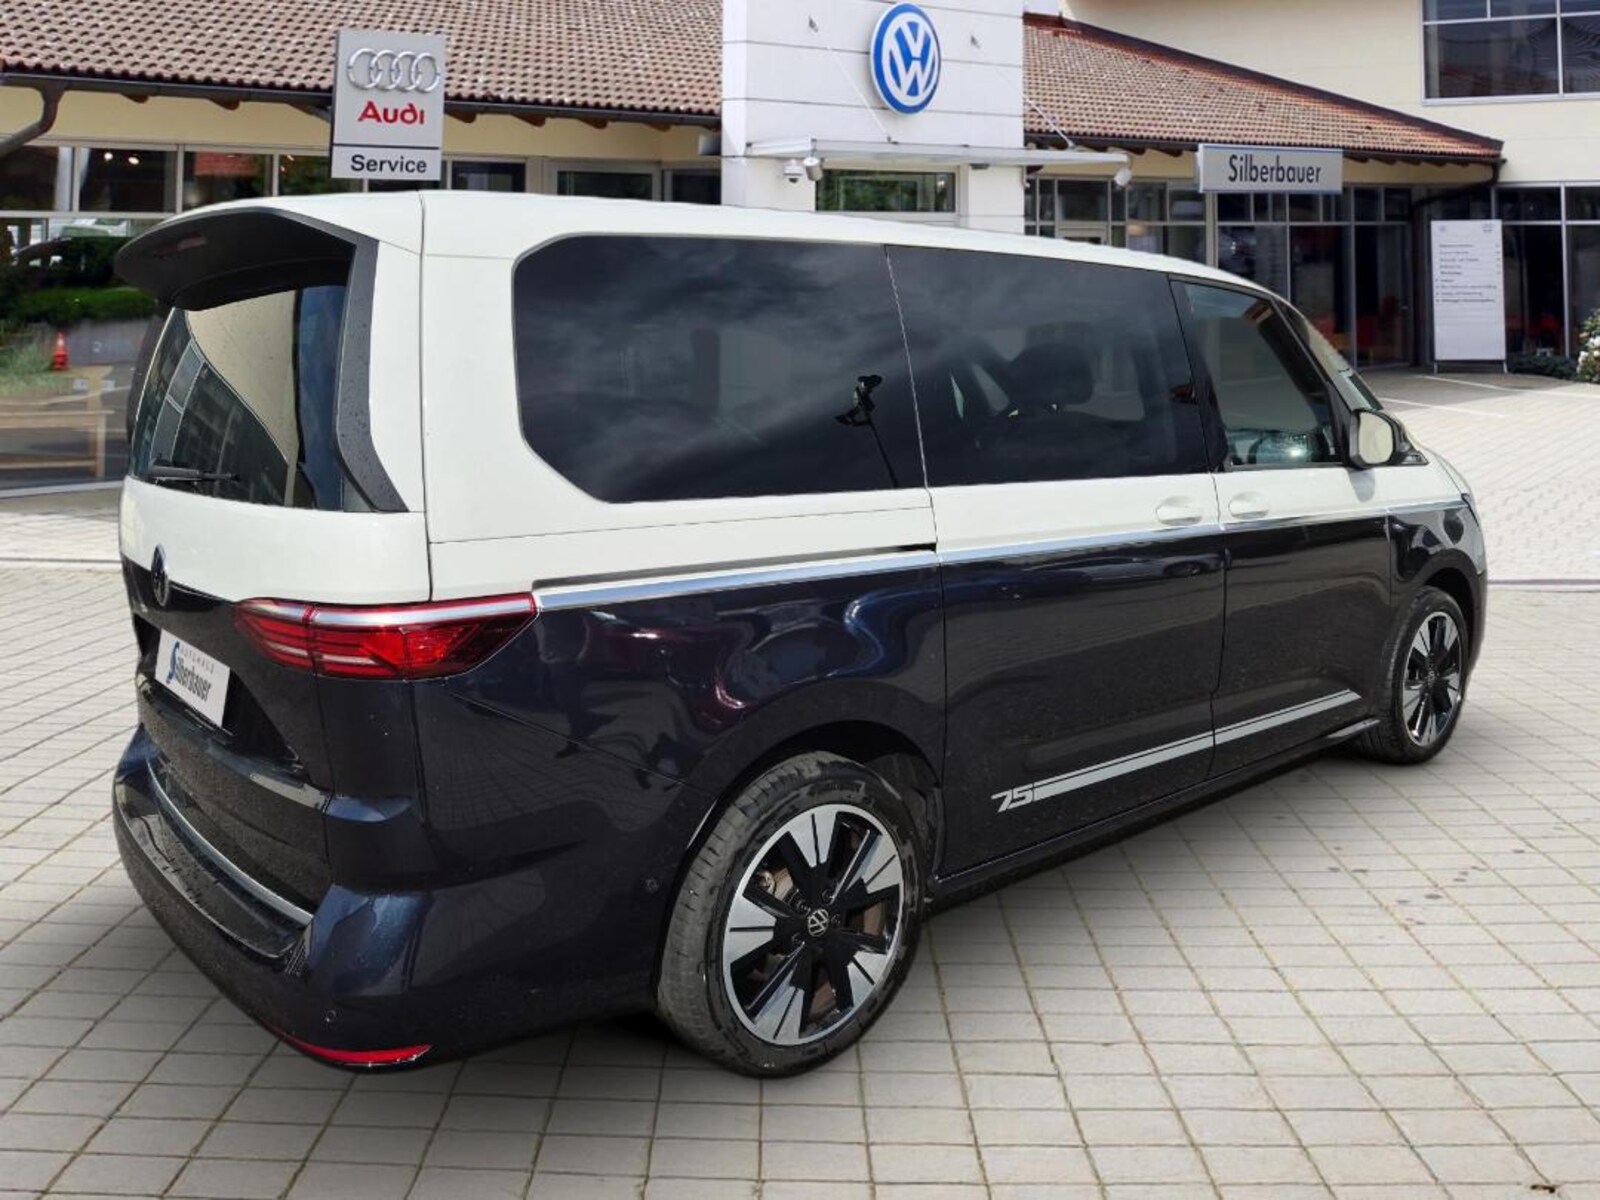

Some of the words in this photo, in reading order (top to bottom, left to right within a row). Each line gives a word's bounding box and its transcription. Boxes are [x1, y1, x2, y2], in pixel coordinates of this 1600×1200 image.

[358, 101, 425, 124] Audi
[351, 154, 427, 173] Service
[1228, 154, 1322, 183] Silberbauer
[991, 783, 1033, 813] 75
